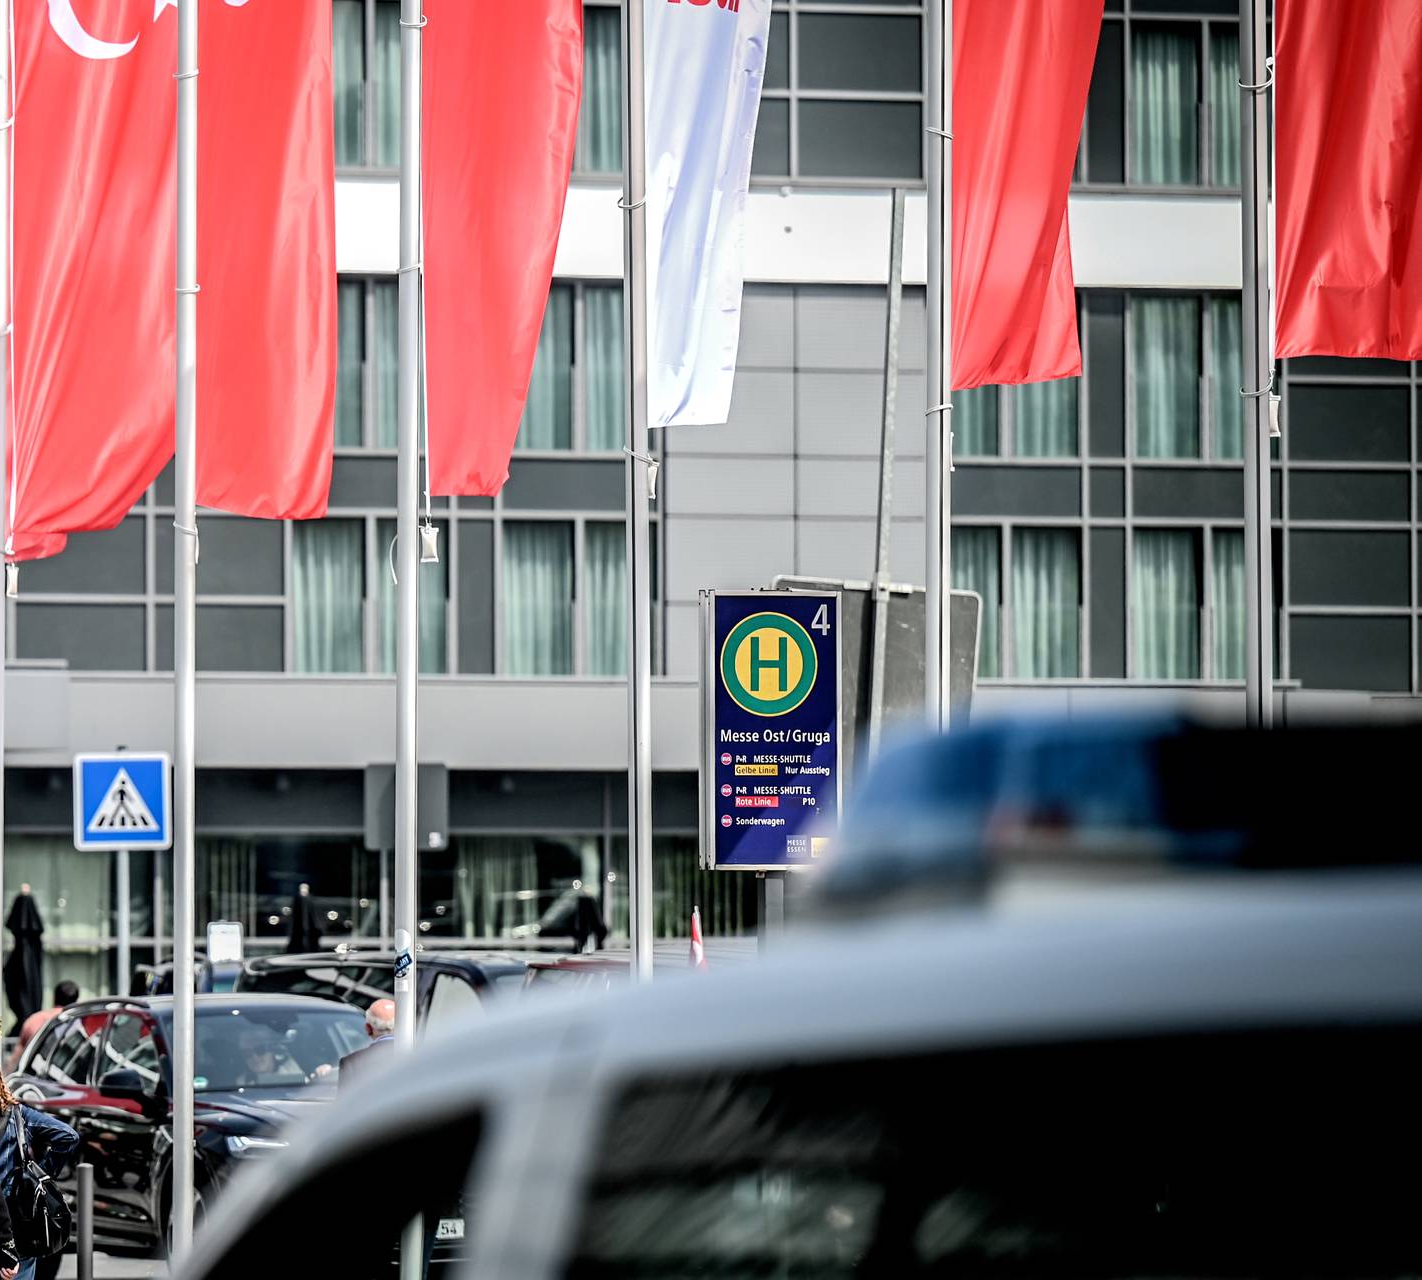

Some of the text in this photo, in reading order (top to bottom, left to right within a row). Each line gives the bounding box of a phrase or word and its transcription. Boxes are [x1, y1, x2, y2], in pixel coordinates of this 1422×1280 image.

[811, 604, 830, 635] 4
[750, 636, 788, 691] H
[720, 729, 759, 742] Messe
[753, 755, 811, 763] MESSE-SHUTTLE
[735, 766, 757, 774] Gelbe
[759, 766, 776, 774] Linie
[800, 766, 830, 777] Ausstieg
[753, 786, 812, 794] MESSE-SHUTTLE
[735, 797, 816, 806] Rote Linie P10
[735, 816, 785, 827] Sonderwagen
